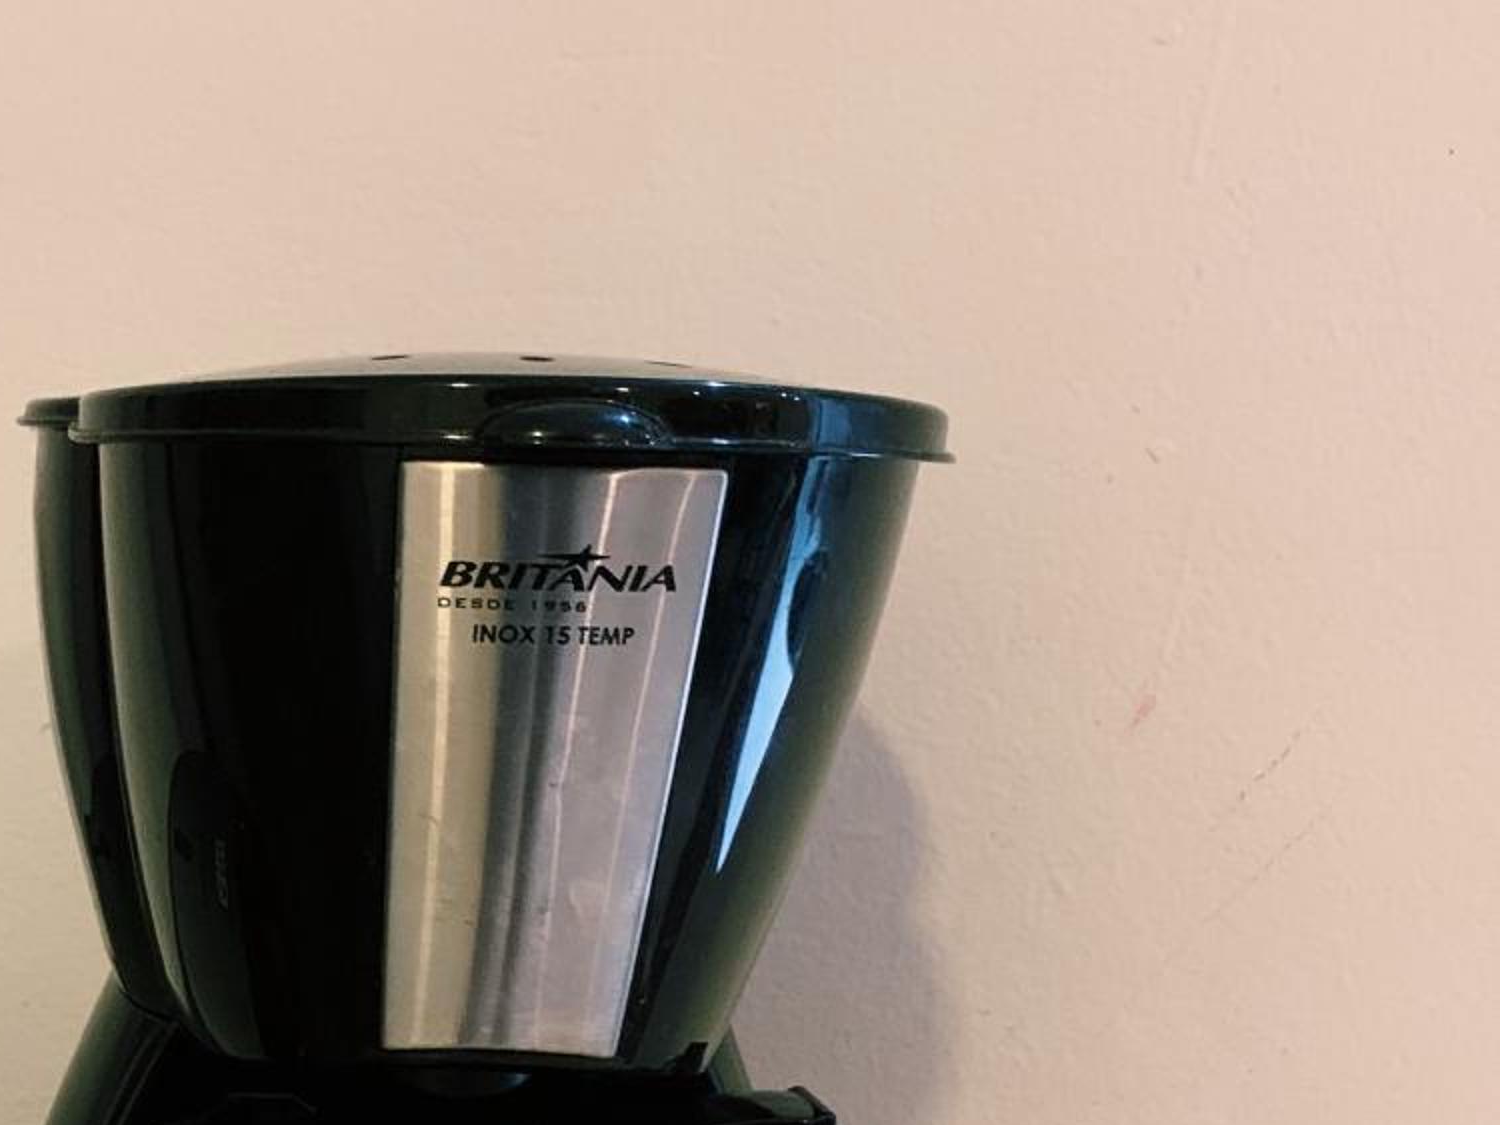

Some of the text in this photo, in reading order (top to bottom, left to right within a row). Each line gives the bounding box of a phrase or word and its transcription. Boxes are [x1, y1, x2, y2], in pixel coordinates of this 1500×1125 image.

[437, 597, 587, 613] DESDE 1956
[472, 623, 635, 646] INOX 15 TEMP
